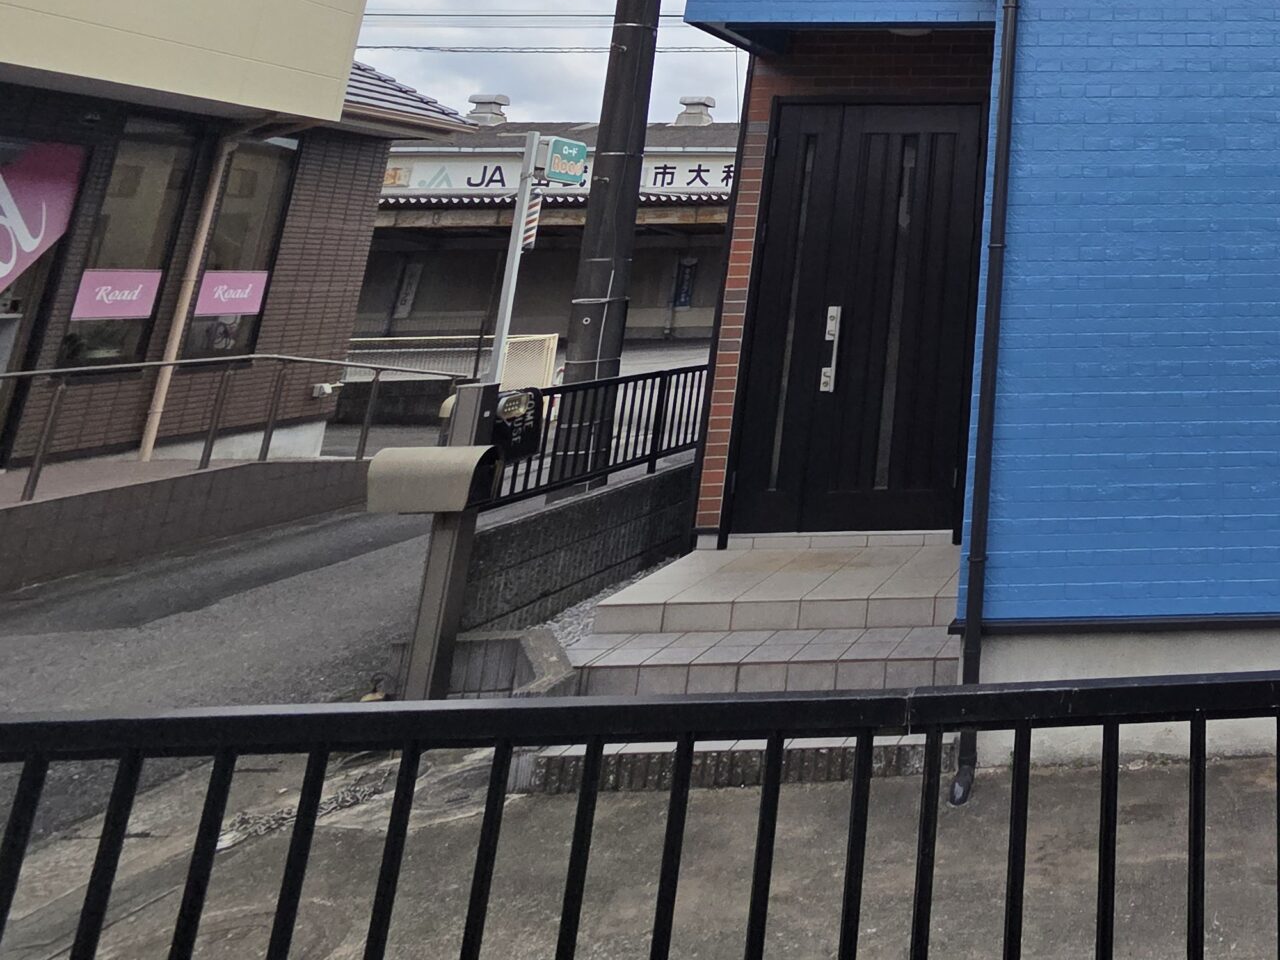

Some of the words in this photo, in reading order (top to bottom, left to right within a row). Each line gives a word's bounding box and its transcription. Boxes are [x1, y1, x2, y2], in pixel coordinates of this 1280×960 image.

[562, 146, 578, 156] ロード
[466, 165, 506, 188] JA
[95, 284, 143, 304] Road
[213, 283, 252, 302] Road
